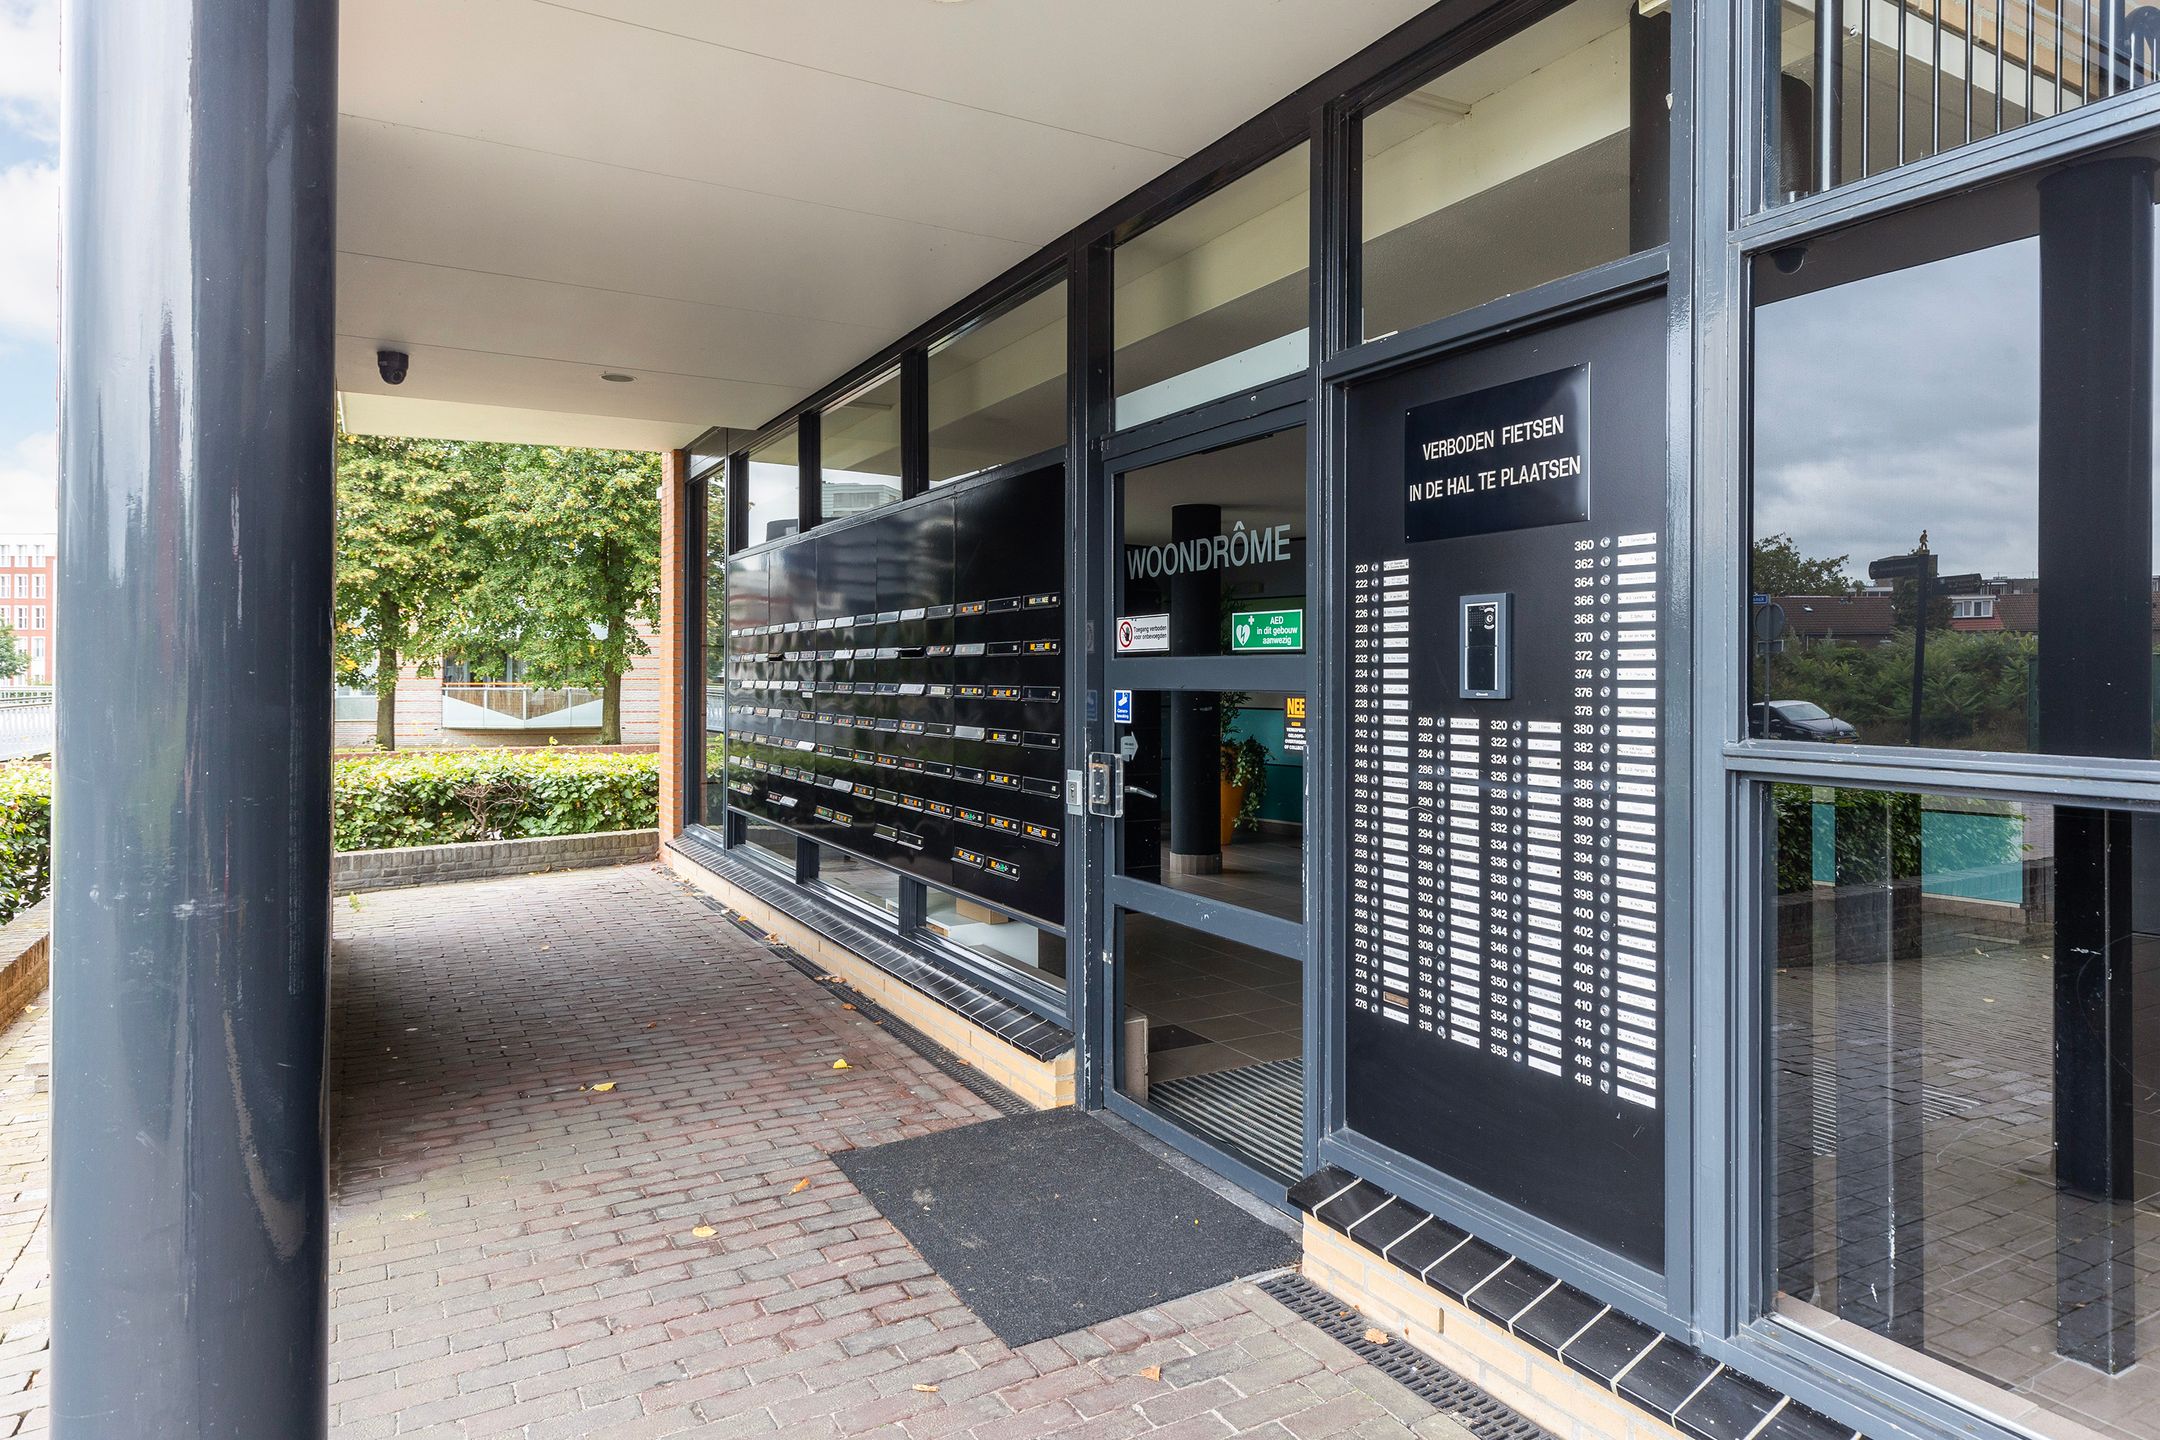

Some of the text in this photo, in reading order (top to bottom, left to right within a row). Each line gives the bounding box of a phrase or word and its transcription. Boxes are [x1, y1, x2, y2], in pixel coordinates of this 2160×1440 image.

[1423, 415, 1564, 460] VERBODEN FIETSEN
[1409, 455, 1580, 502] IN DE HAL TE PLAATSEN
[1127, 521, 1291, 580] WOONDRÔME
[1574, 540, 1594, 552] 360
[1355, 564, 1368, 573] 220
[1575, 558, 1594, 569] 362
[1356, 580, 1368, 588] 222
[1574, 577, 1594, 588] 364
[1356, 595, 1368, 603] 224
[1574, 595, 1594, 606] 366
[1356, 610, 1368, 618] 226
[1574, 614, 1594, 624] 368
[1270, 616, 1283, 625] AED
[1264, 626, 1272, 634] dit
[1273, 626, 1298, 636] gebouw
[1355, 625, 1368, 633] 228
[1263, 635, 1292, 645] aanwezig
[1575, 632, 1593, 642] 370
[1355, 640, 1368, 648] 230
[1356, 655, 1368, 663] 232
[1575, 651, 1593, 661] 372
[1355, 669, 1368, 677] 234
[1575, 669, 1593, 679] 374
[1355, 685, 1368, 693] 236
[1575, 687, 1593, 697] 376
[1287, 698, 1305, 715] NEE
[1355, 699, 1368, 708] 238
[1575, 706, 1593, 716] 378
[1355, 714, 1368, 723] 240
[1418, 717, 1433, 726] 280
[1491, 720, 1507, 730] 320
[1573, 724, 1594, 734] 380
[1355, 729, 1367, 738] 242
[1418, 733, 1433, 742] 282
[1491, 737, 1507, 747] 322
[1574, 742, 1593, 753] 382
[1355, 744, 1368, 753] 244
[1418, 749, 1433, 758] 284
[1355, 759, 1368, 768] 246
[1491, 754, 1507, 764] 324
[1418, 765, 1433, 774] 286
[1574, 760, 1593, 771] 384
[1355, 774, 1368, 783] 248
[1491, 771, 1507, 781] 326
[1418, 781, 1433, 790] 288
[1573, 779, 1594, 791] 386
[1355, 789, 1367, 798] 250
[1490, 787, 1508, 799] 328
[1418, 797, 1433, 806] 290
[1573, 797, 1593, 808] 388
[1355, 804, 1367, 813] 252
[1490, 805, 1508, 816] 330
[1418, 813, 1432, 822] 292
[1573, 815, 1593, 827] 390
[1355, 819, 1367, 828] 254
[1491, 822, 1507, 833] 332
[1355, 834, 1367, 843] 256
[1418, 828, 1433, 838] 294
[1490, 839, 1507, 850] 334
[1574, 834, 1593, 845] 392
[1355, 849, 1367, 858] 258
[1418, 844, 1433, 854] 296
[1490, 856, 1508, 868] 336
[1574, 852, 1593, 864] 394
[1355, 864, 1368, 873] 260
[1418, 860, 1433, 871] 298
[1418, 876, 1433, 887] 300
[1491, 873, 1507, 885] 338
[1574, 870, 1593, 882] 396
[1355, 879, 1367, 889] 262
[1355, 894, 1368, 903] 264
[1418, 892, 1433, 903] 302
[1491, 890, 1508, 902] 340
[1573, 888, 1593, 901] 398
[1355, 908, 1368, 919] 266
[1418, 908, 1433, 919] 304
[1491, 907, 1507, 919] 342
[1573, 907, 1594, 919] 400
[1355, 923, 1368, 934] 268
[1418, 924, 1433, 935] 306
[1491, 924, 1508, 936] 344
[1573, 925, 1593, 938] 402
[1355, 938, 1367, 949] 270
[1418, 940, 1433, 951] 308
[1491, 941, 1508, 954] 346
[1573, 944, 1594, 956] 404
[1355, 954, 1367, 964] 272
[1419, 956, 1433, 967] 310
[1491, 958, 1508, 971] 348
[1355, 969, 1367, 979] 274
[1573, 962, 1593, 975] 406
[1419, 972, 1432, 983] 312
[1491, 975, 1508, 988] 350
[1355, 983, 1367, 994] 276
[1573, 980, 1594, 993] 408
[1419, 988, 1432, 999] 314
[1491, 993, 1507, 1005] 352
[1355, 998, 1367, 1009] 278
[1574, 999, 1592, 1012] 410
[1419, 1004, 1432, 1015] 316
[1491, 1010, 1507, 1022] 354
[1419, 1020, 1432, 1031] 318
[1575, 1017, 1592, 1030] 412
[1491, 1027, 1508, 1040] 356
[1575, 1036, 1592, 1049] 414
[1491, 1044, 1508, 1057] 358
[1575, 1054, 1592, 1067] 416
[1575, 1073, 1592, 1086] 418
